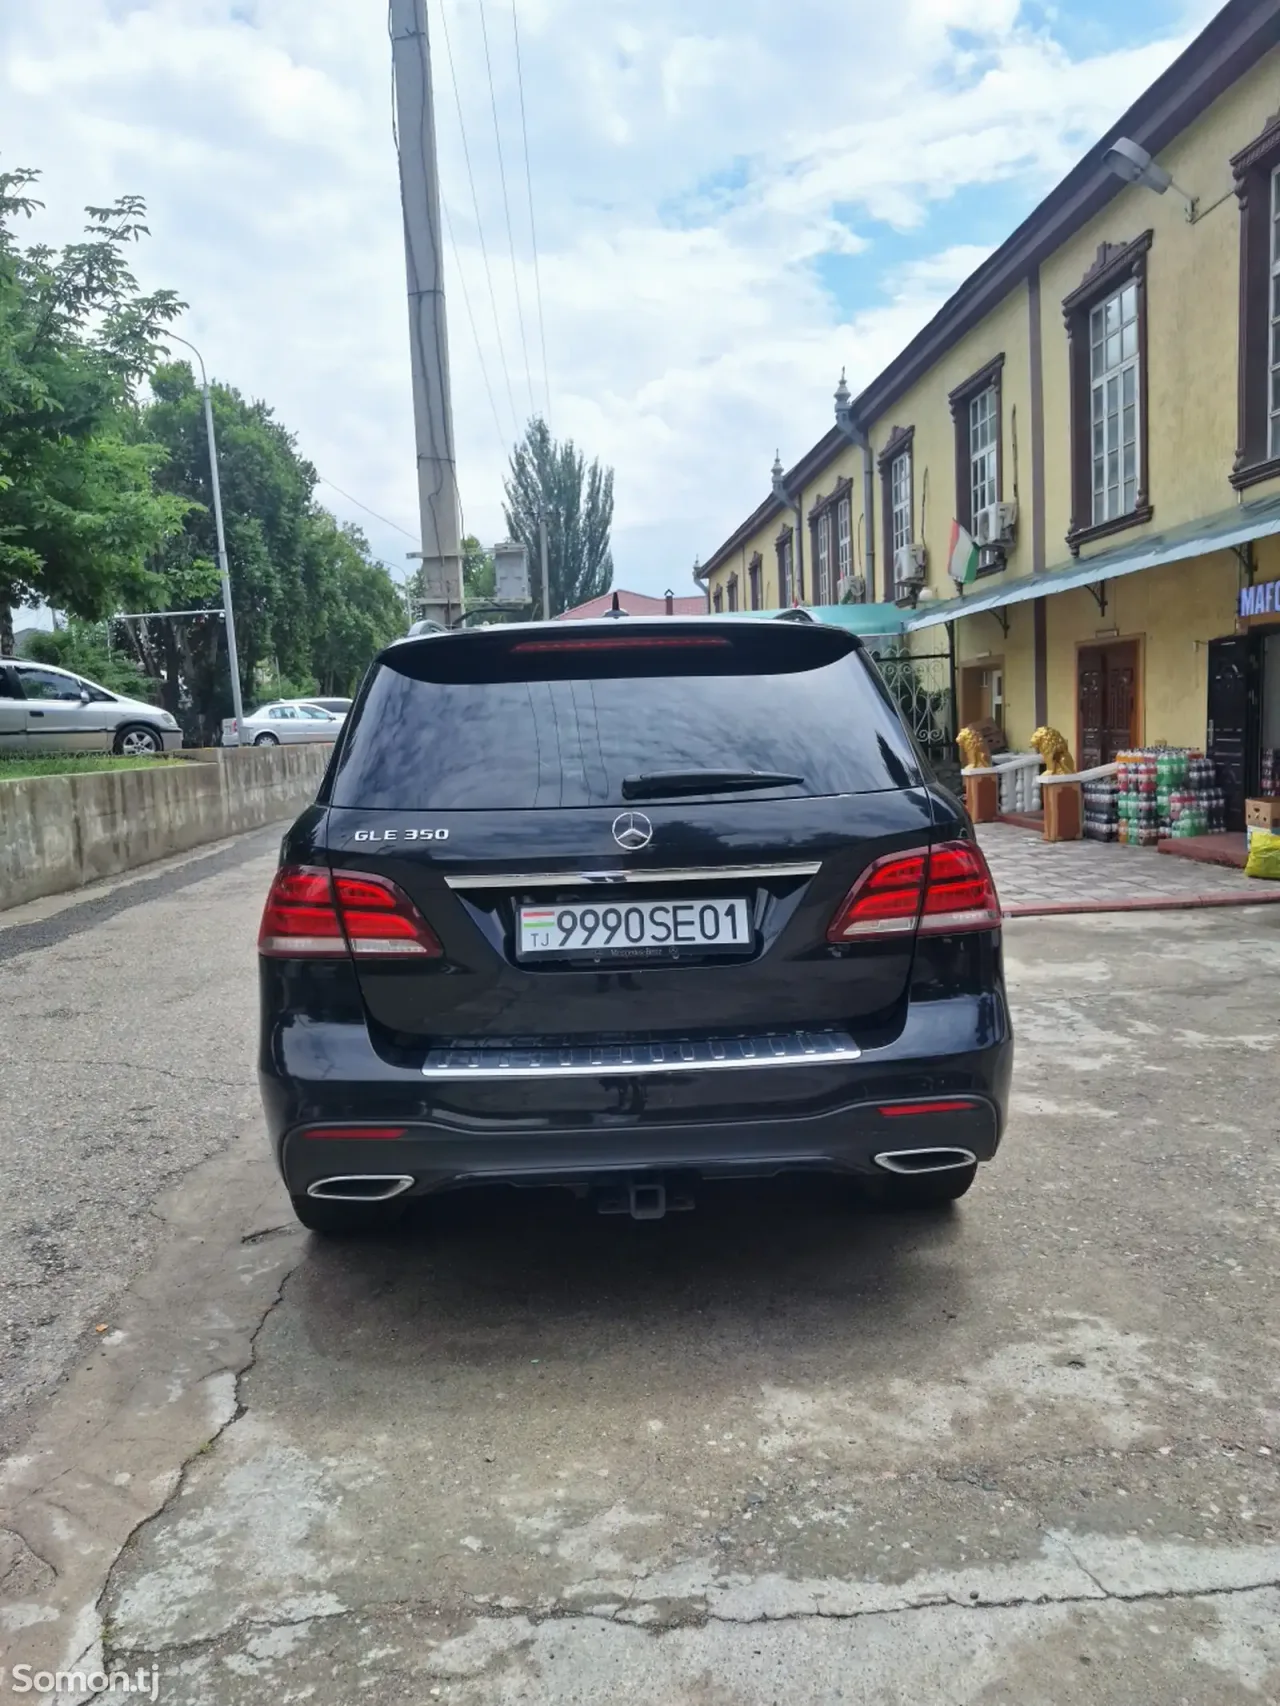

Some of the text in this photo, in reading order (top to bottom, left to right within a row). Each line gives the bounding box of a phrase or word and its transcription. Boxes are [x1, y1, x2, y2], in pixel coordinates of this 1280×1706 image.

[354, 828, 449, 841] GLE 350
[556, 903, 738, 947] 9990SE01
[530, 932, 550, 948] TJ
